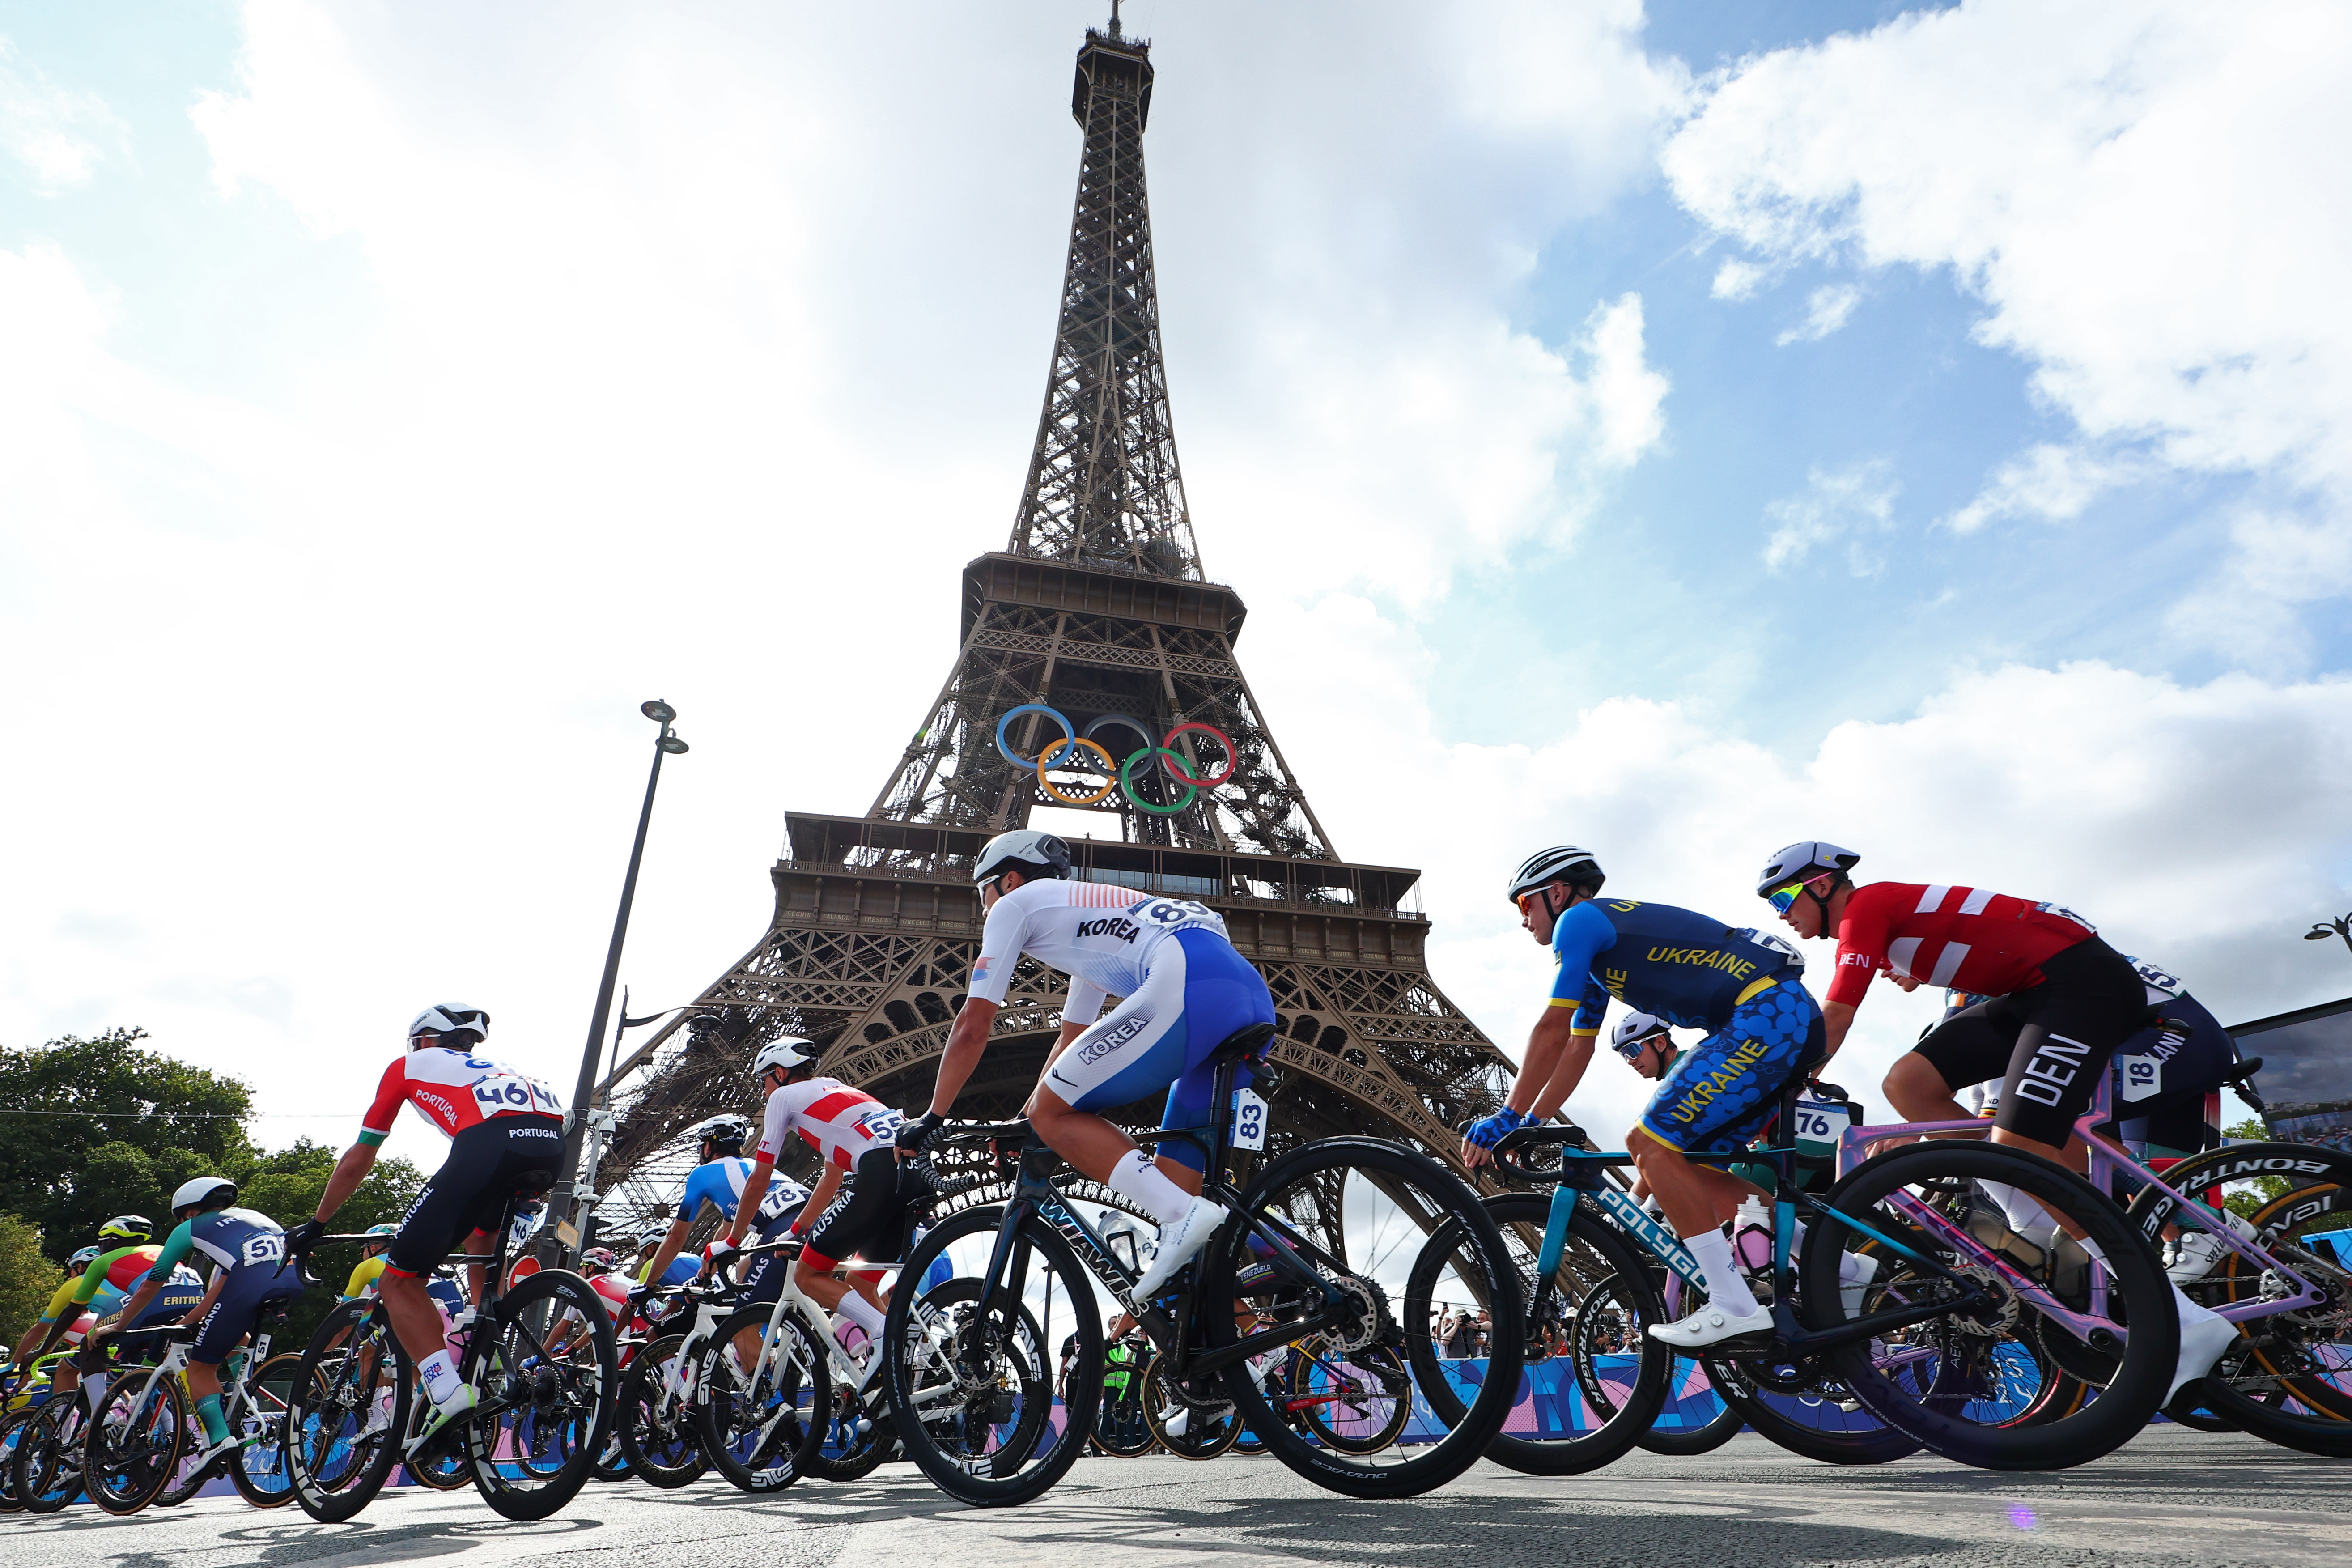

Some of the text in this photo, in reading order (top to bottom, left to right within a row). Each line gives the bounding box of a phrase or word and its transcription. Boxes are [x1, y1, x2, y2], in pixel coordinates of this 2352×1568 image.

[1527, 857, 1550, 876] LAZER
[1077, 918, 1141, 944] KOREA
[1646, 946, 1757, 981] UKRAINE
[1839, 953, 1870, 968] DEN
[1078, 1016, 1148, 1065] KOREA
[1671, 1039, 1769, 1123] UKRAINE
[2015, 1033, 2092, 1107] DEN
[2129, 1062, 2154, 1086] 18
[475, 1082, 529, 1106] 46
[416, 1088, 459, 1127] PORTUGAL
[509, 1127, 559, 1139] PORTUGAL
[1240, 1104, 1261, 1140] 83
[1797, 1112, 1830, 1136] 76
[765, 1188, 797, 1210] 78
[395, 1186, 434, 1240] PORTUGAL
[811, 1188, 855, 1243] AUSTRIA
[514, 1219, 527, 1241] 46
[251, 1239, 278, 1258] 51
[1240, 1264, 1272, 1281] VENEZUELA
[1526, 1271, 1541, 1317] POLYGON
[194, 1302, 222, 1347] IRELAND
[258, 1341, 267, 1354] 51
[1579, 1289, 1610, 1405] BONTRAGER
[177, 1374, 204, 1432] cannondale
[209, 1444, 226, 1458] nimbl
[1027, 1430, 1070, 1483] DURA-ACE
[1310, 1458, 1388, 1479] DURA-ACE
